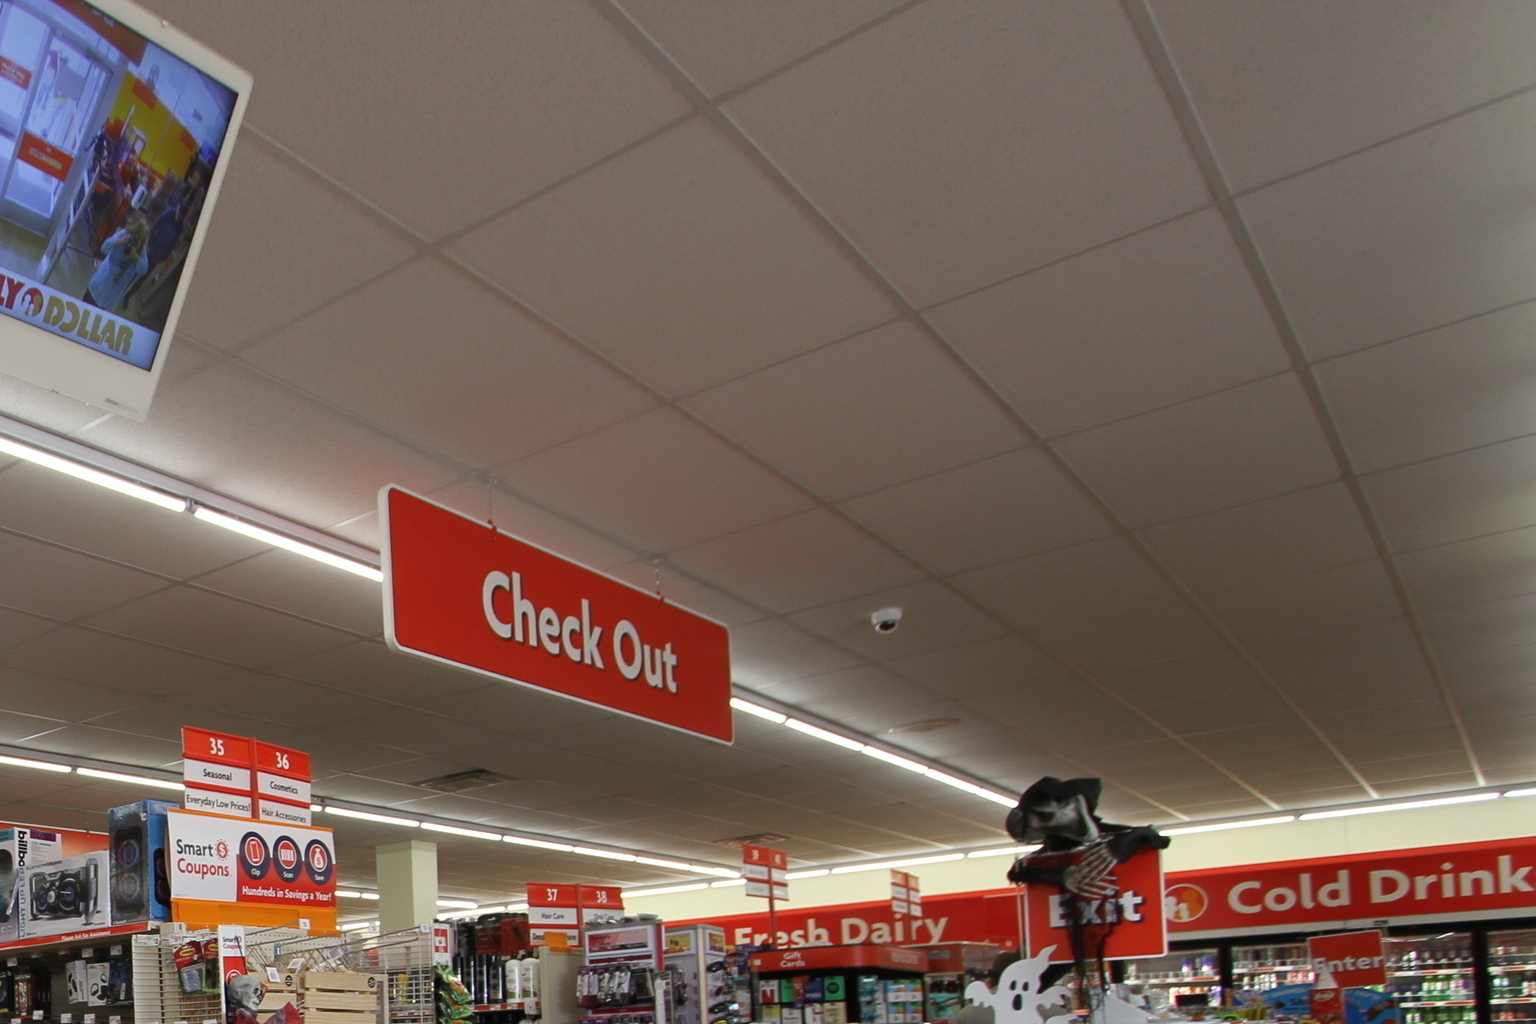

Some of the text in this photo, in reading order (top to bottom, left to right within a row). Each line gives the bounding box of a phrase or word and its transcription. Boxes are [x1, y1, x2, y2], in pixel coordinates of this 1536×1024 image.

[42, 295, 135, 356] DOLLAR
[482, 570, 678, 694] Check Out
[209, 737, 225, 756] 35
[275, 752, 290, 770] 36
[202, 768, 233, 782] Seasonal
[269, 780, 299, 795] Cosmetics
[186, 794, 251, 812] Everyday Low Prices!
[261, 807, 307, 824] Hair Accessories
[17, 830, 28, 868] billbo
[176, 838, 214, 858] Smart
[177, 857, 230, 880] Coupons
[250, 868, 261, 877] Clip
[282, 871, 294, 879] Scan
[314, 874, 325, 882] Save
[1226, 854, 1536, 915] Cold Drink
[242, 885, 332, 902] Hundreds in Savings a Year!
[546, 888, 559, 902] 37
[596, 891, 608, 904] 38
[1048, 890, 1144, 928] Exit
[734, 912, 949, 948] Fresh Dairy
[779, 960, 806, 968] Cards
[782, 951, 802, 960] Gift
[1311, 956, 1385, 973] Enter
